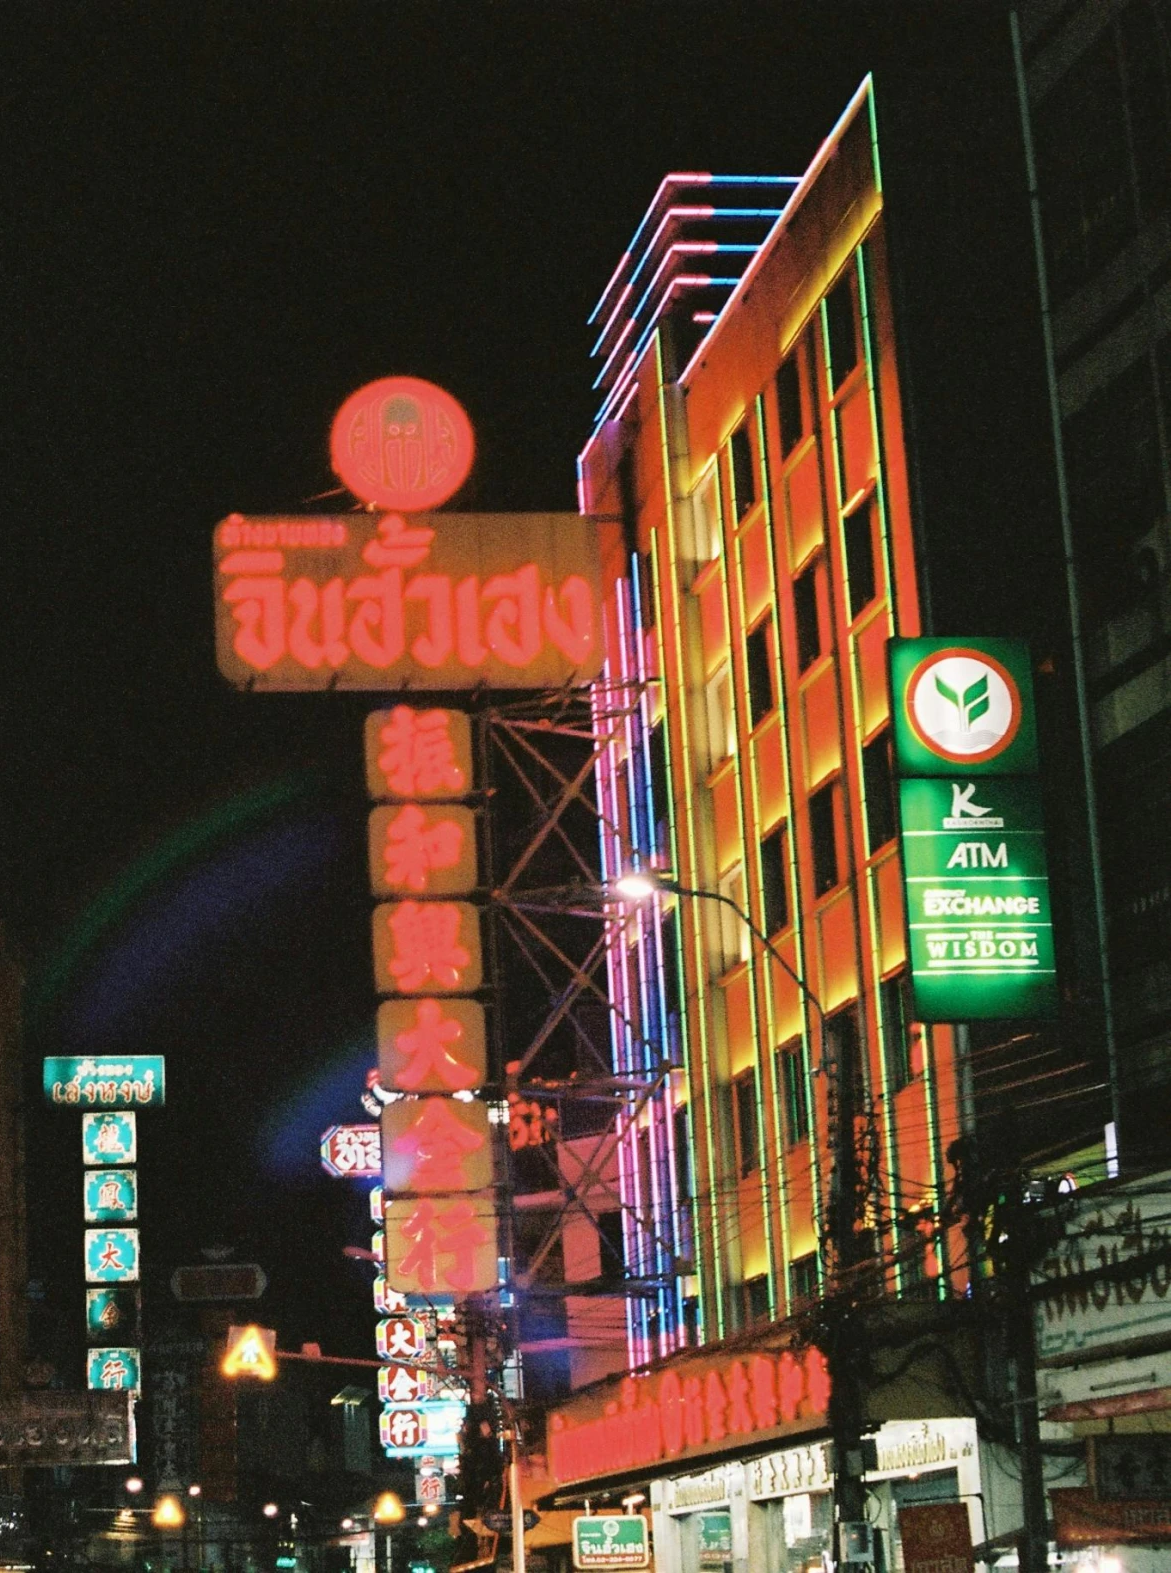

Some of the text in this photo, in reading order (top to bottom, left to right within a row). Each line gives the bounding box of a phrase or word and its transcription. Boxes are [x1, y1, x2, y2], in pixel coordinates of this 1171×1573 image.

[951, 783, 993, 818] K
[947, 842, 1008, 869] ATM
[924, 897, 1040, 916] EXCHANGE
[970, 931, 995, 941] THE
[927, 940, 1038, 959] WISDOM
